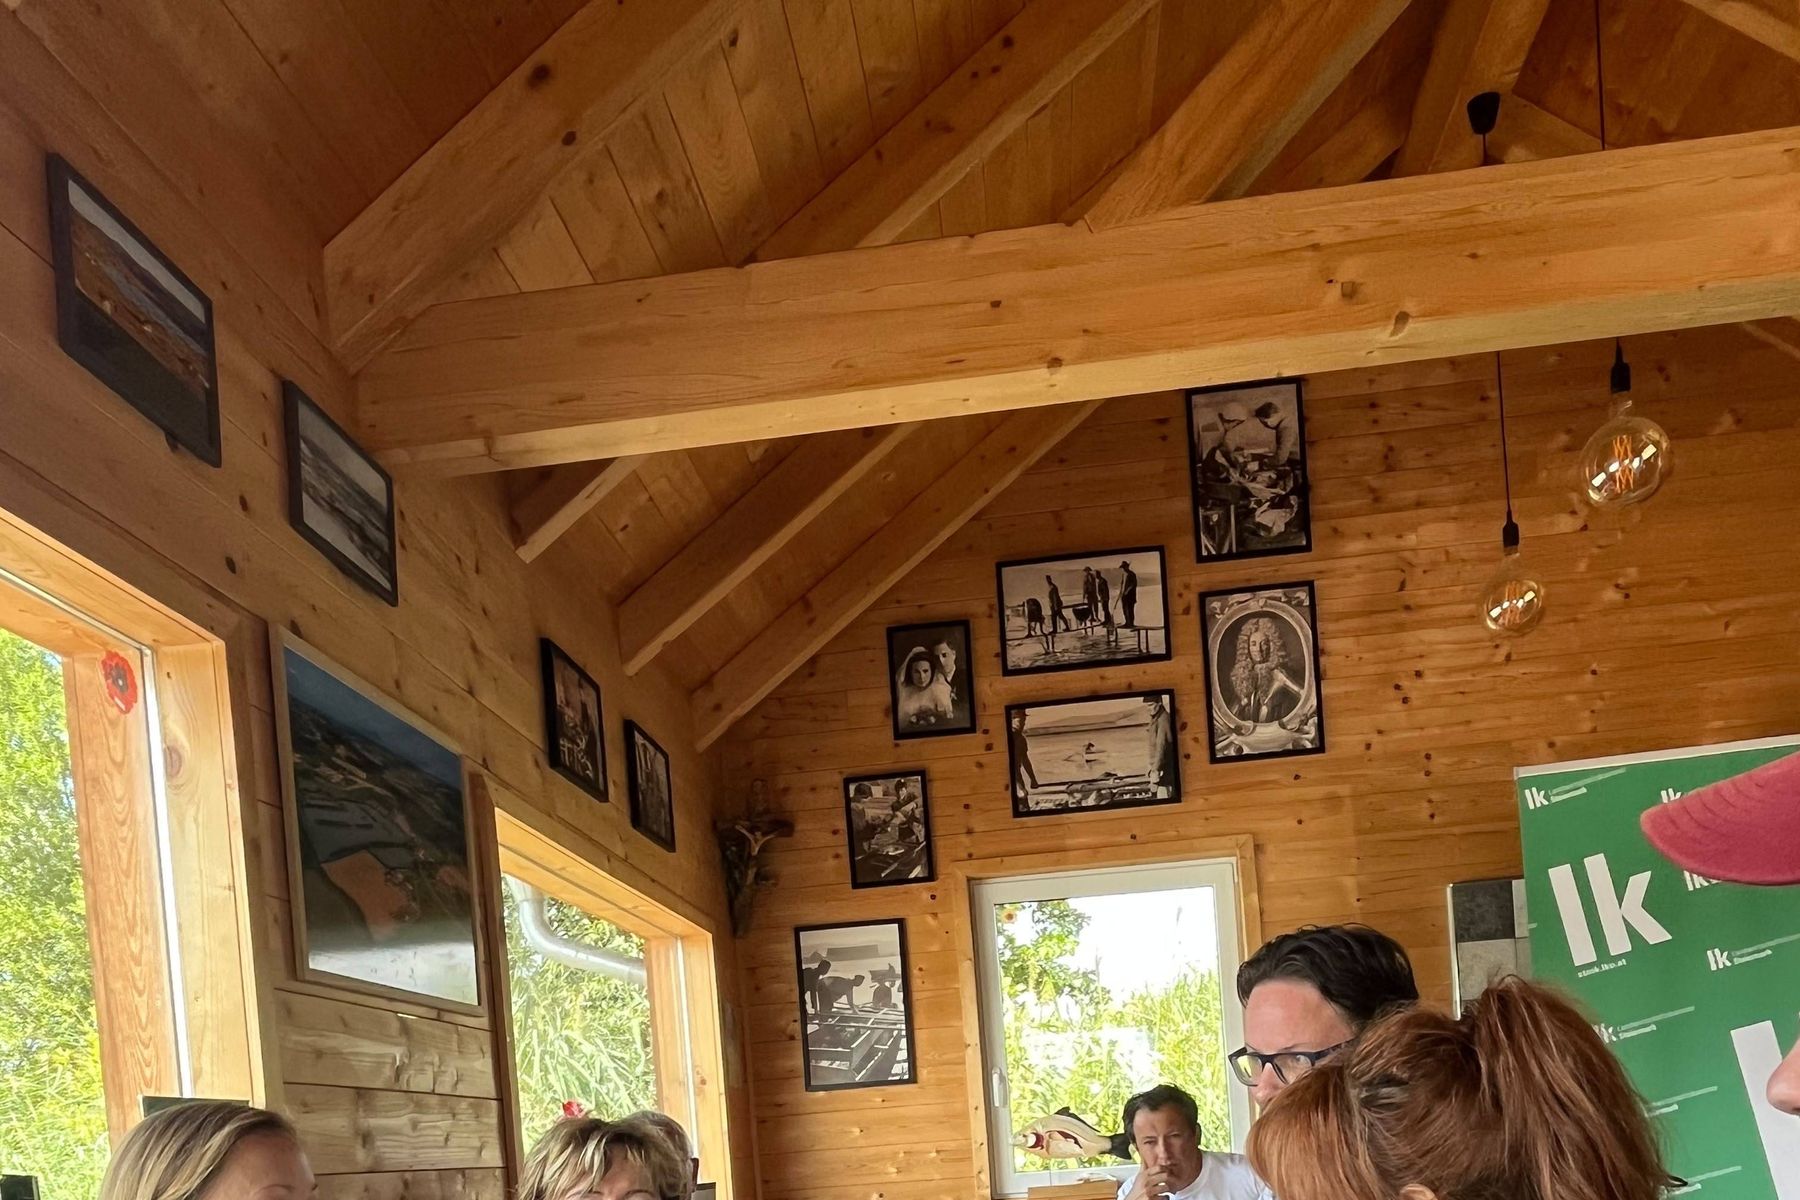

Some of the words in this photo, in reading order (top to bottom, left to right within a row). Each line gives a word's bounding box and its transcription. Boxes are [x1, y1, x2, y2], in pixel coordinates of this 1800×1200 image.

[1524, 787, 1549, 809] lk
[1547, 853, 1673, 967] lk
[1706, 948, 1732, 971] lk
